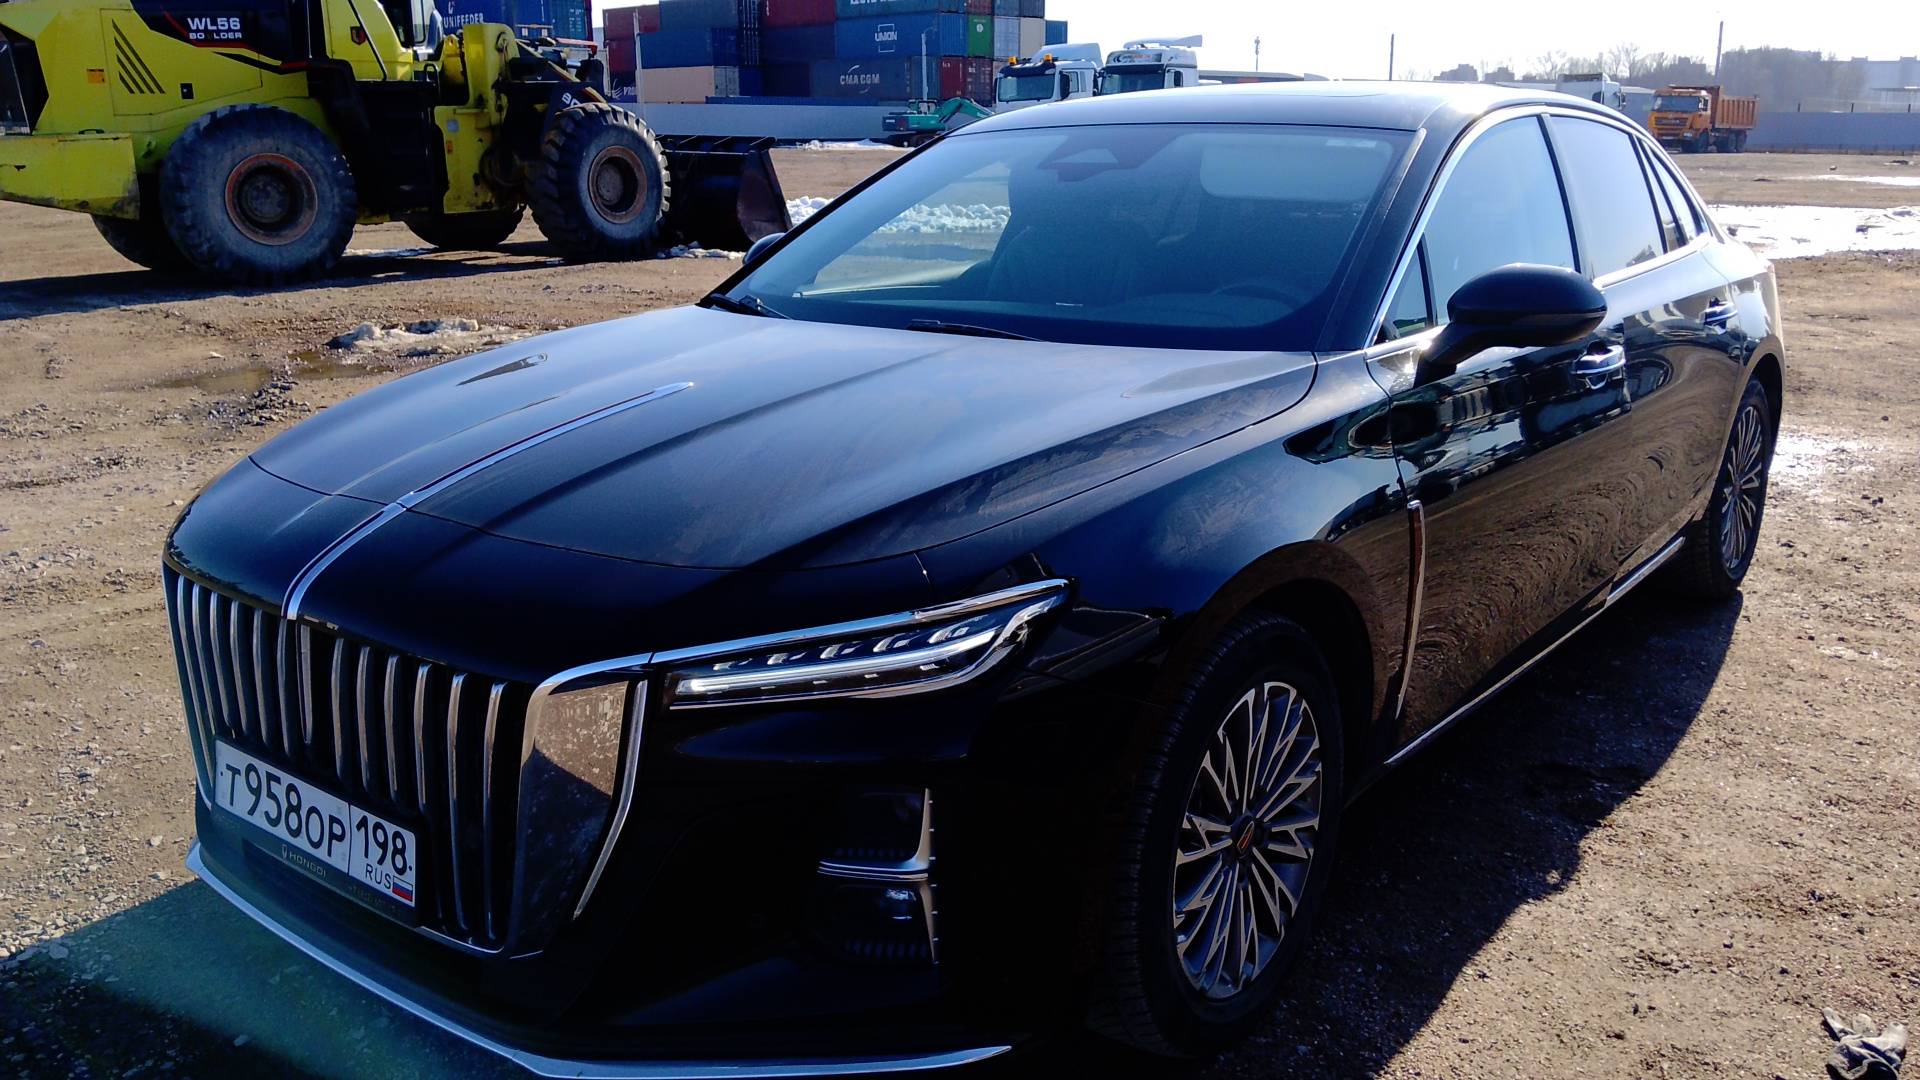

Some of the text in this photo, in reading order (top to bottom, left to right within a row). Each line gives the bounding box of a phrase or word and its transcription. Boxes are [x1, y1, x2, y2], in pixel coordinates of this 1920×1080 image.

[187, 17, 241, 30] WL56
[443, 13, 484, 28] UNIFEEDER
[356, 815, 407, 876] 198
[365, 863, 391, 889] RUS
